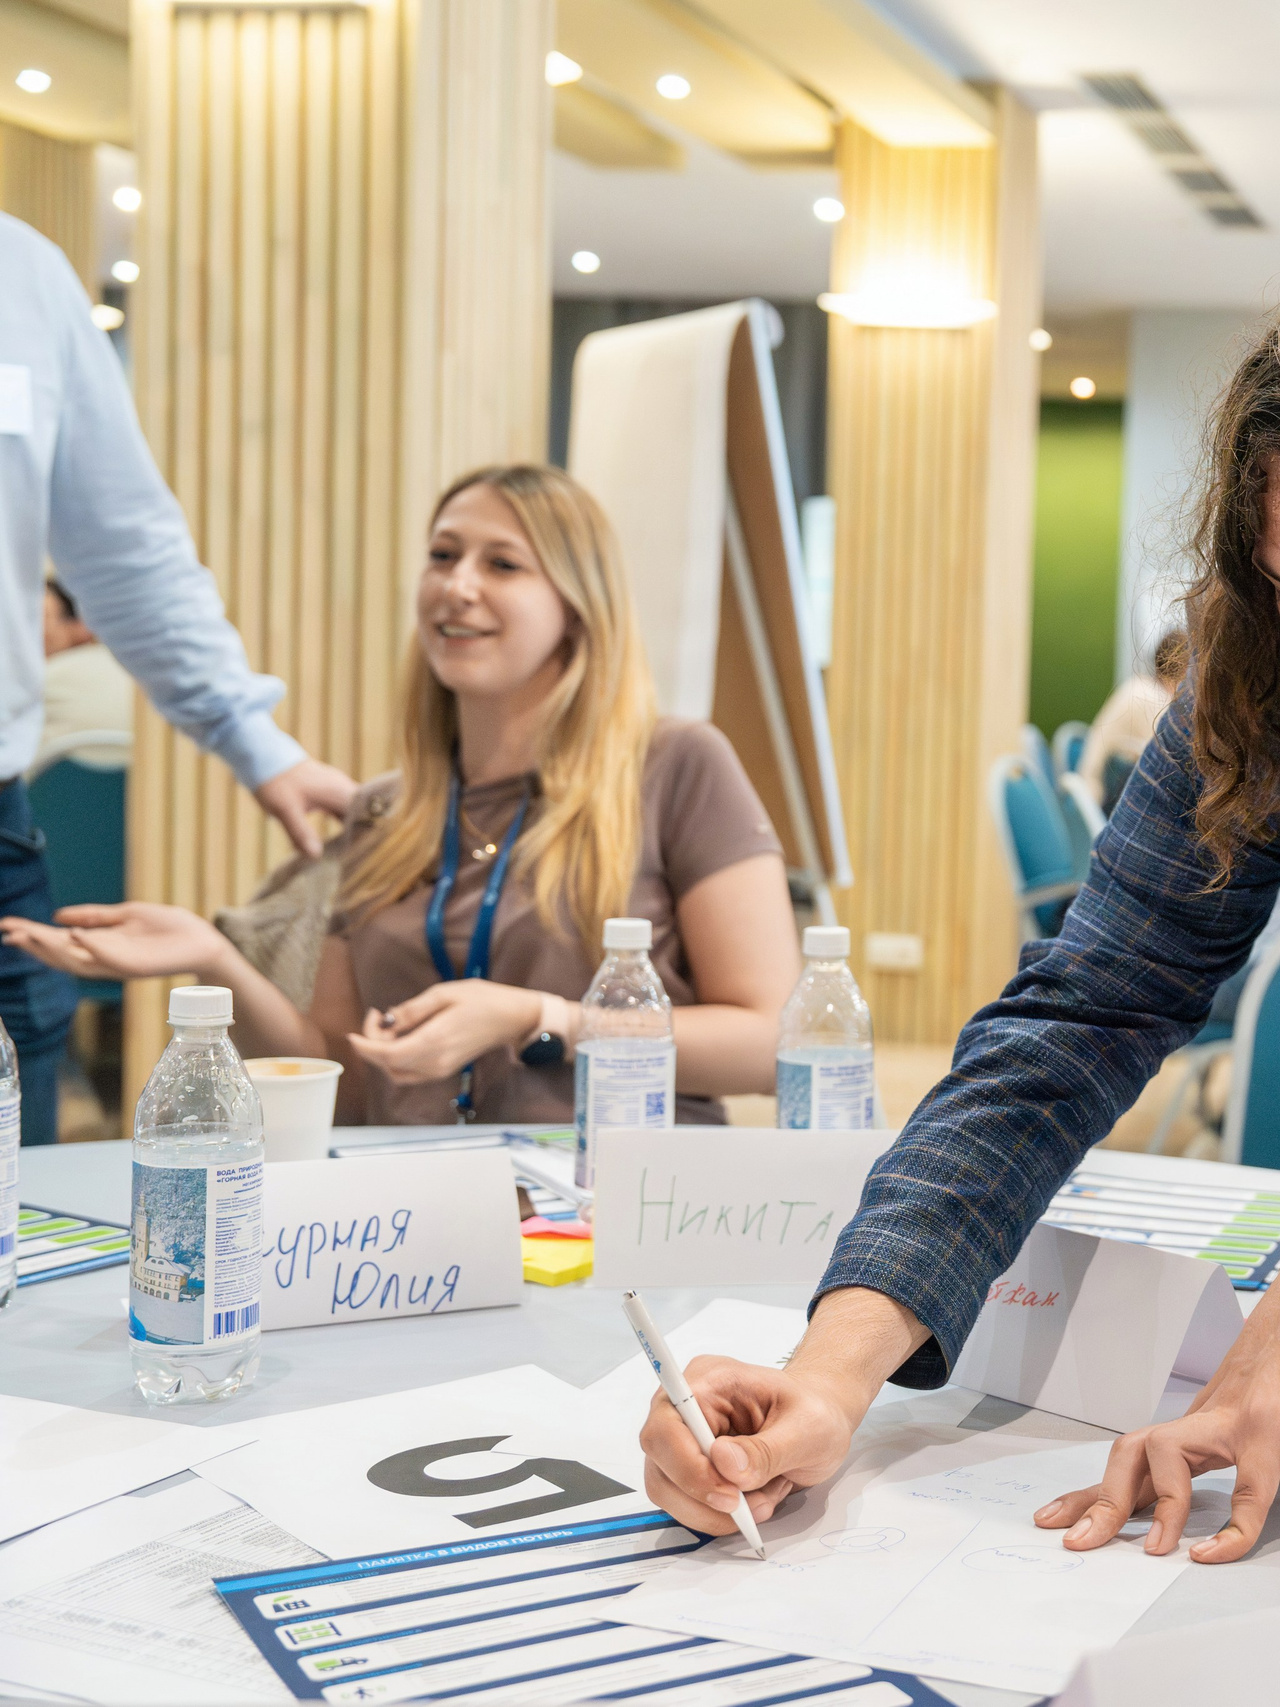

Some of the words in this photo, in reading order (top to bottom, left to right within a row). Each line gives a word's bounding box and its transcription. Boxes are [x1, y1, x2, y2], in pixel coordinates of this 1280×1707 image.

[216, 1168, 236, 1177] ВОДА
[358, 1551, 435, 1570] ПАМЯТКА
[451, 1539, 510, 1554] ВИДОВ
[511, 1530, 574, 1545] ПОТЕРЬ
